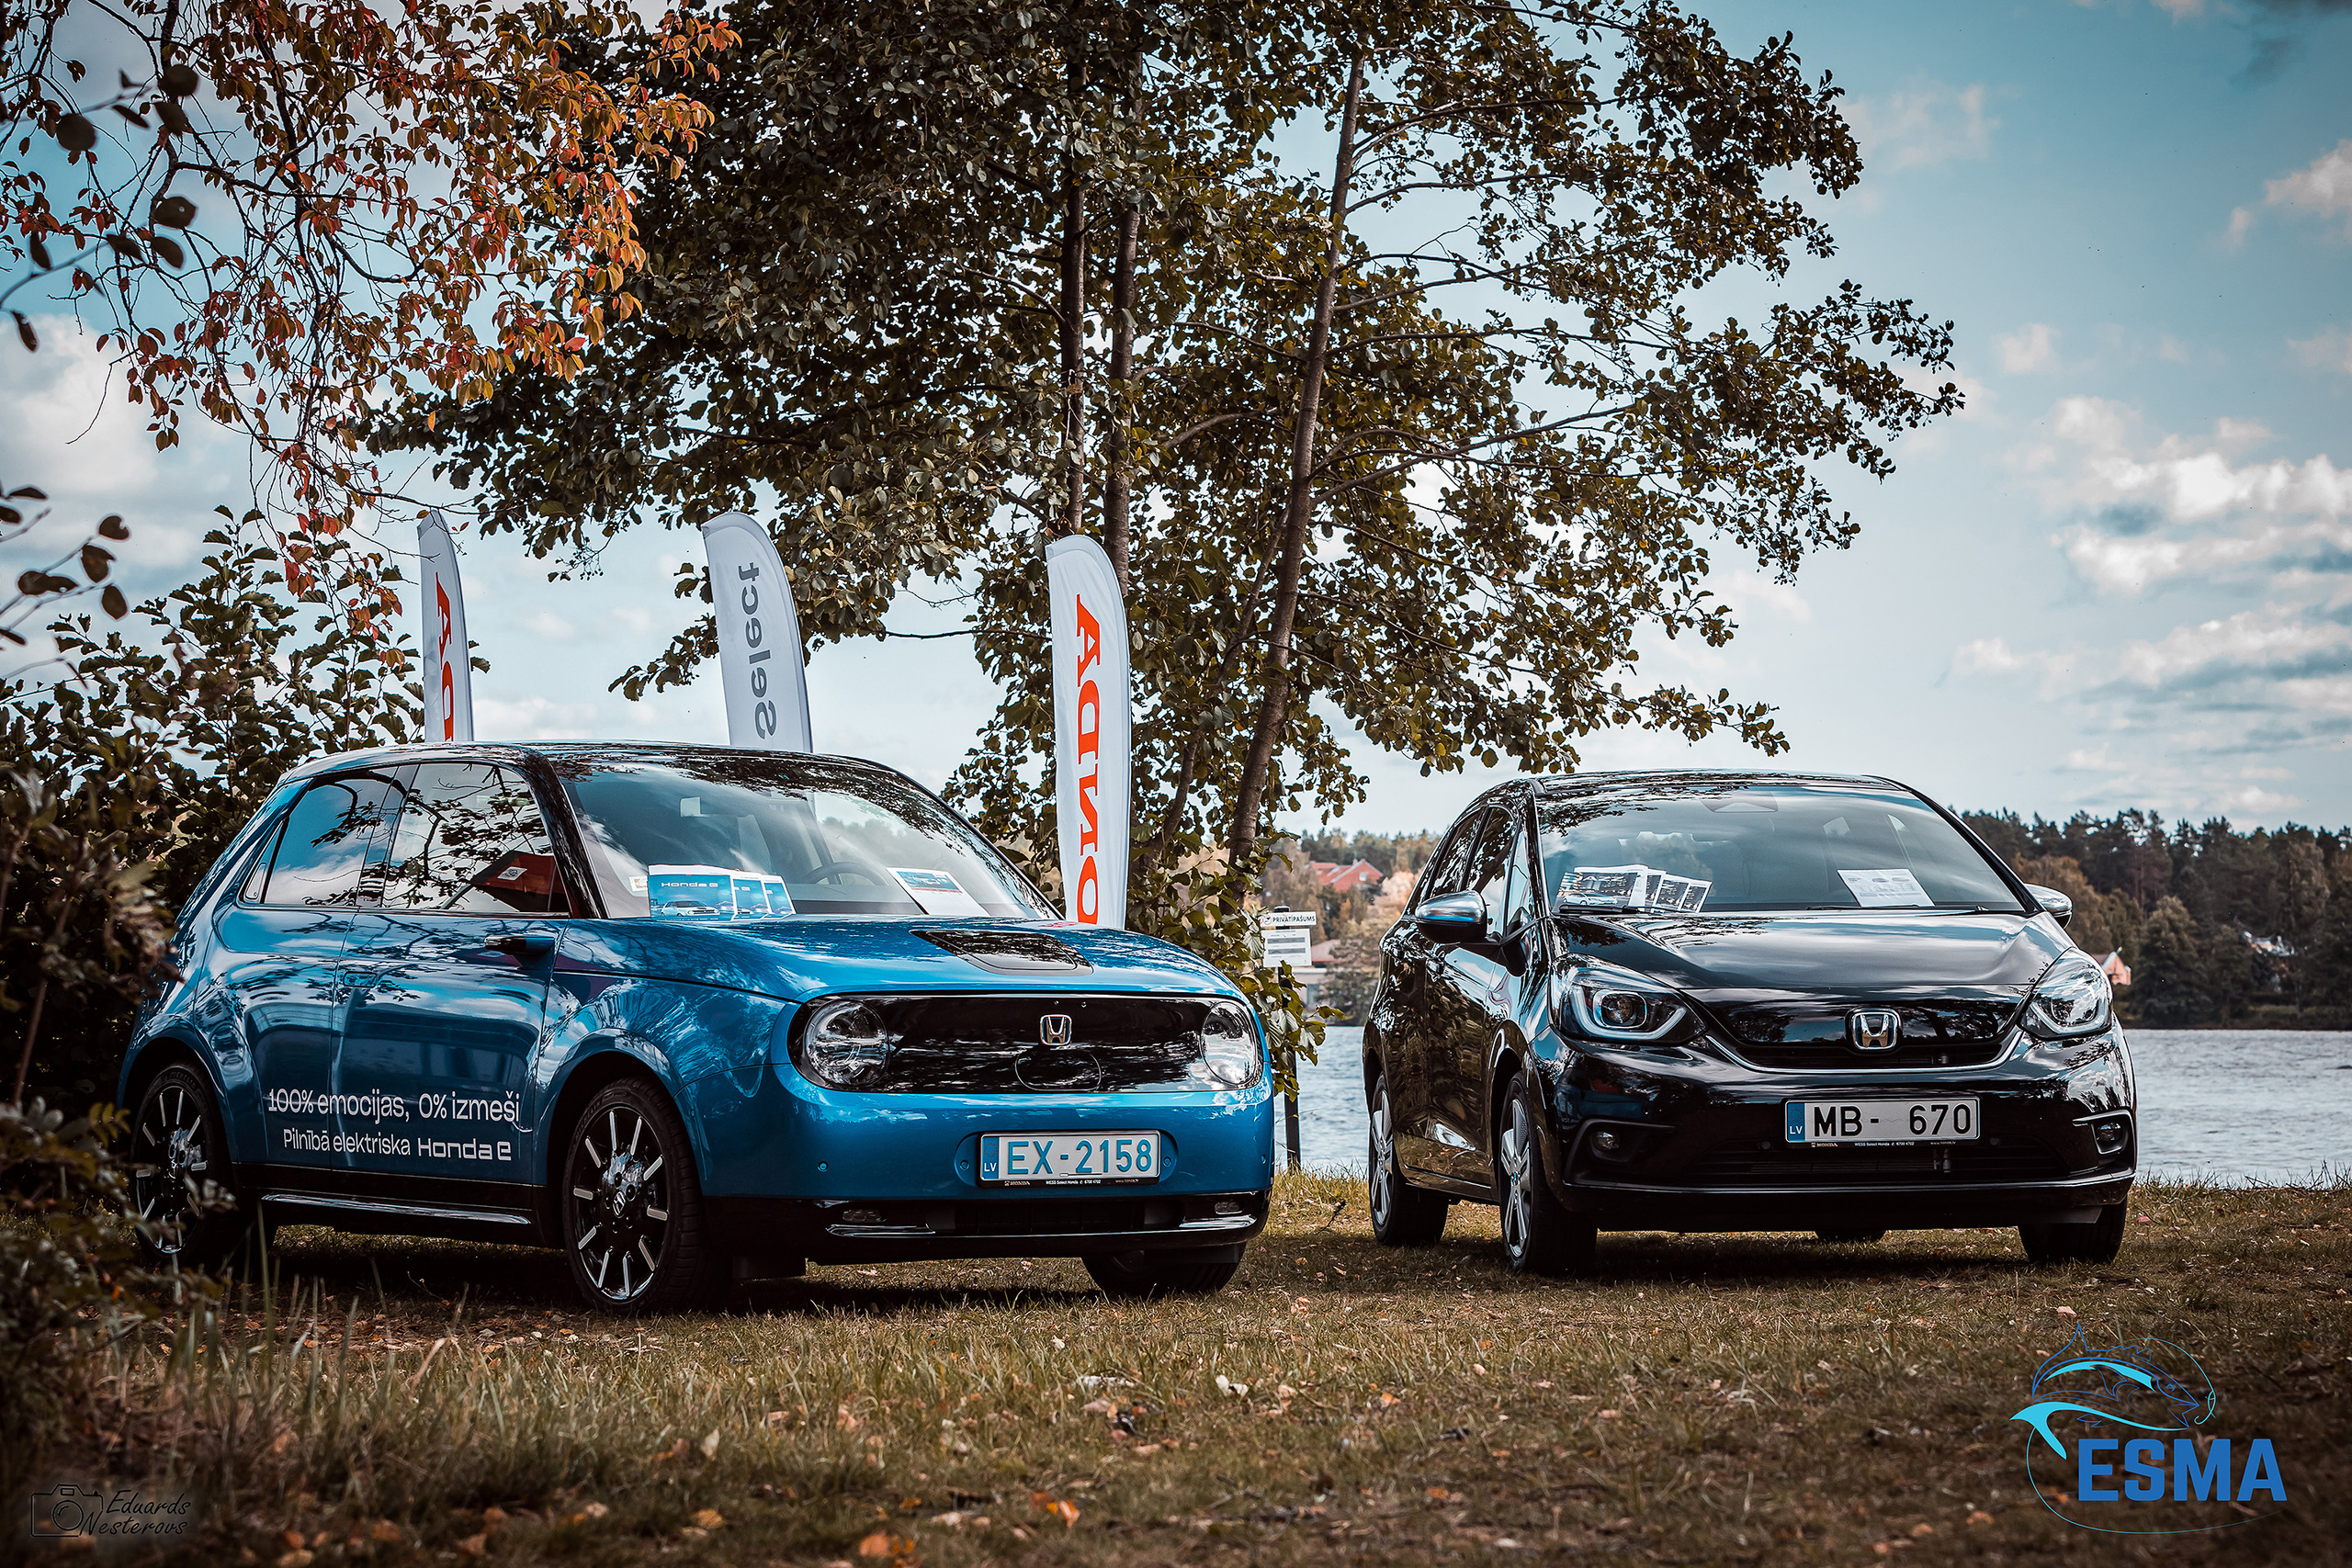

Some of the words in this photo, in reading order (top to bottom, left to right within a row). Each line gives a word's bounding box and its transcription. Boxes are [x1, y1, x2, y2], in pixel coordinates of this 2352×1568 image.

[267, 1088, 314, 1114] 100%
[317, 1089, 410, 1124] emocijas,
[418, 1092, 447, 1119] 0%
[452, 1090, 520, 1122] izmeši
[283, 1128, 330, 1151] Pilnībā
[333, 1132, 411, 1155] elektriska
[418, 1137, 492, 1160] Honda
[1790, 1125, 1803, 1134] LV
[984, 1162, 997, 1172] LV
[1007, 1139, 1152, 1175] EX-2158
